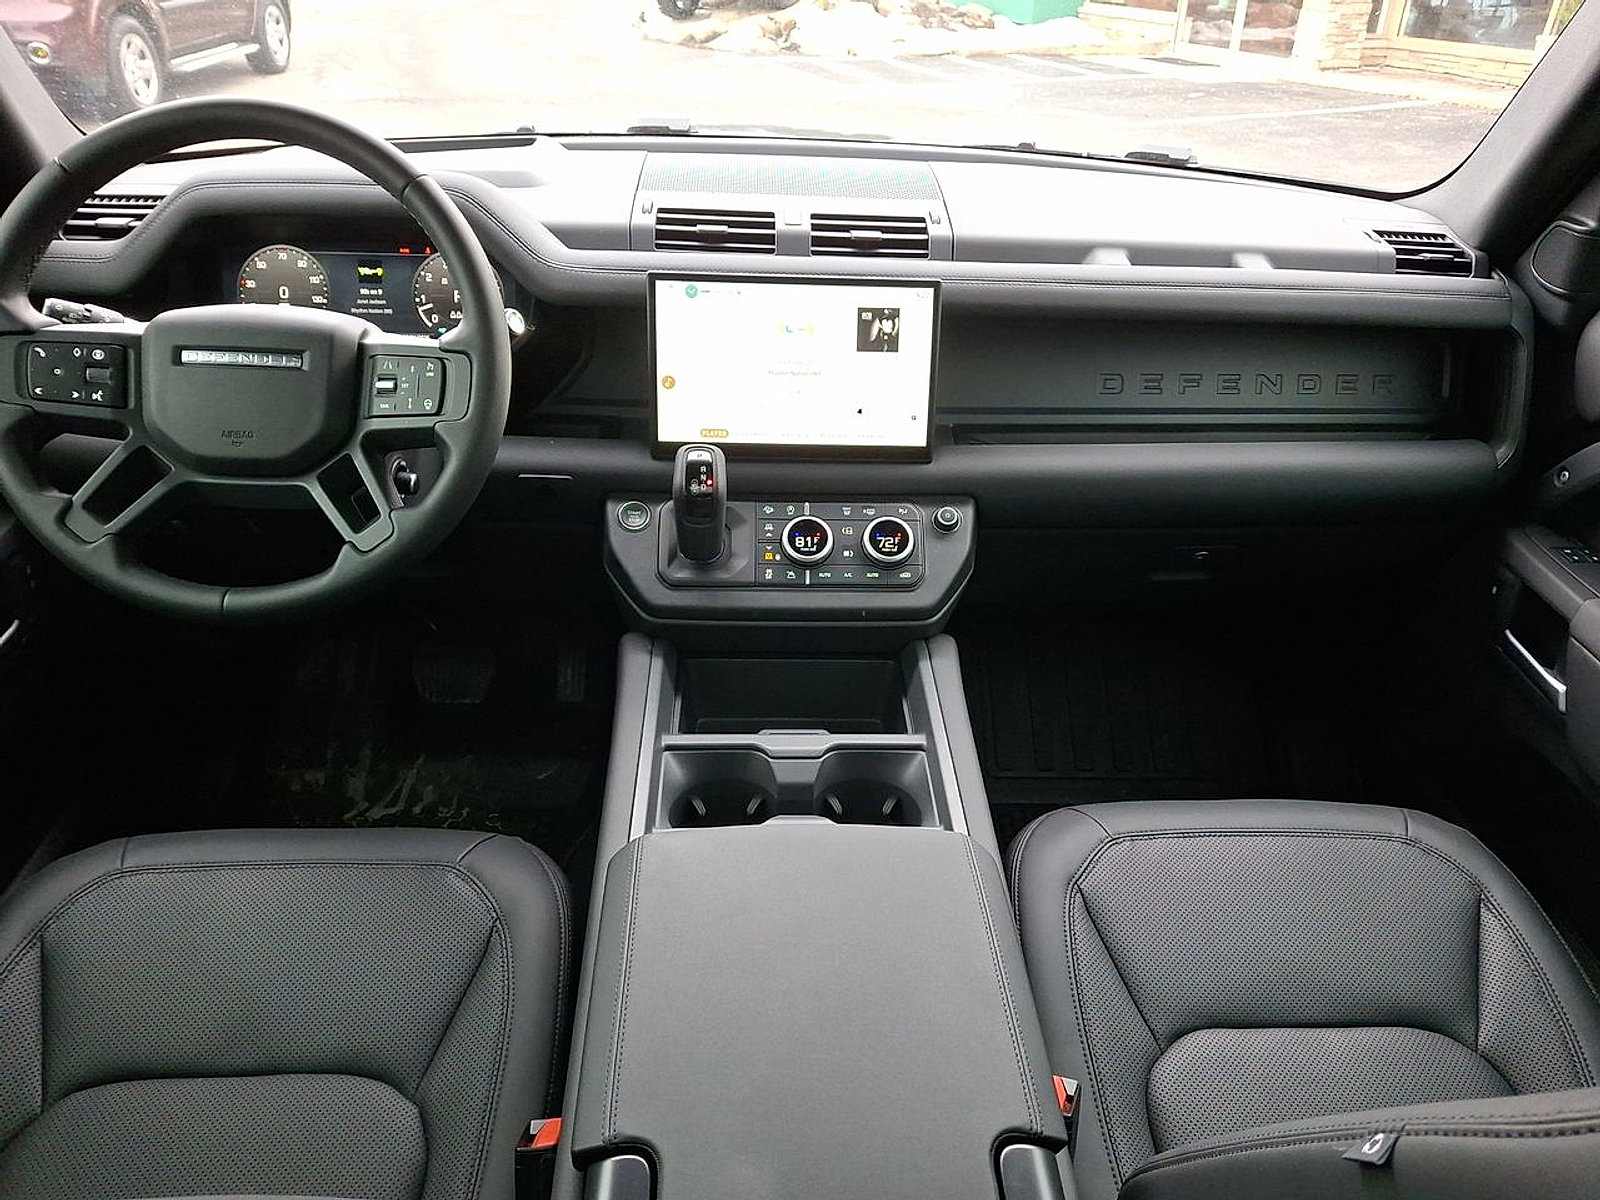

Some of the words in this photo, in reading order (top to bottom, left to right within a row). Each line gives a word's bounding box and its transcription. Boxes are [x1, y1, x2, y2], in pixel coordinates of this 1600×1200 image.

[278, 252, 287, 260] 70
[425, 272, 433, 282] 2
[278, 285, 289, 299] 0
[431, 313, 439, 324] 0
[1099, 373, 1399, 395] DEFENDER
[221, 430, 254, 439] AIRBAG
